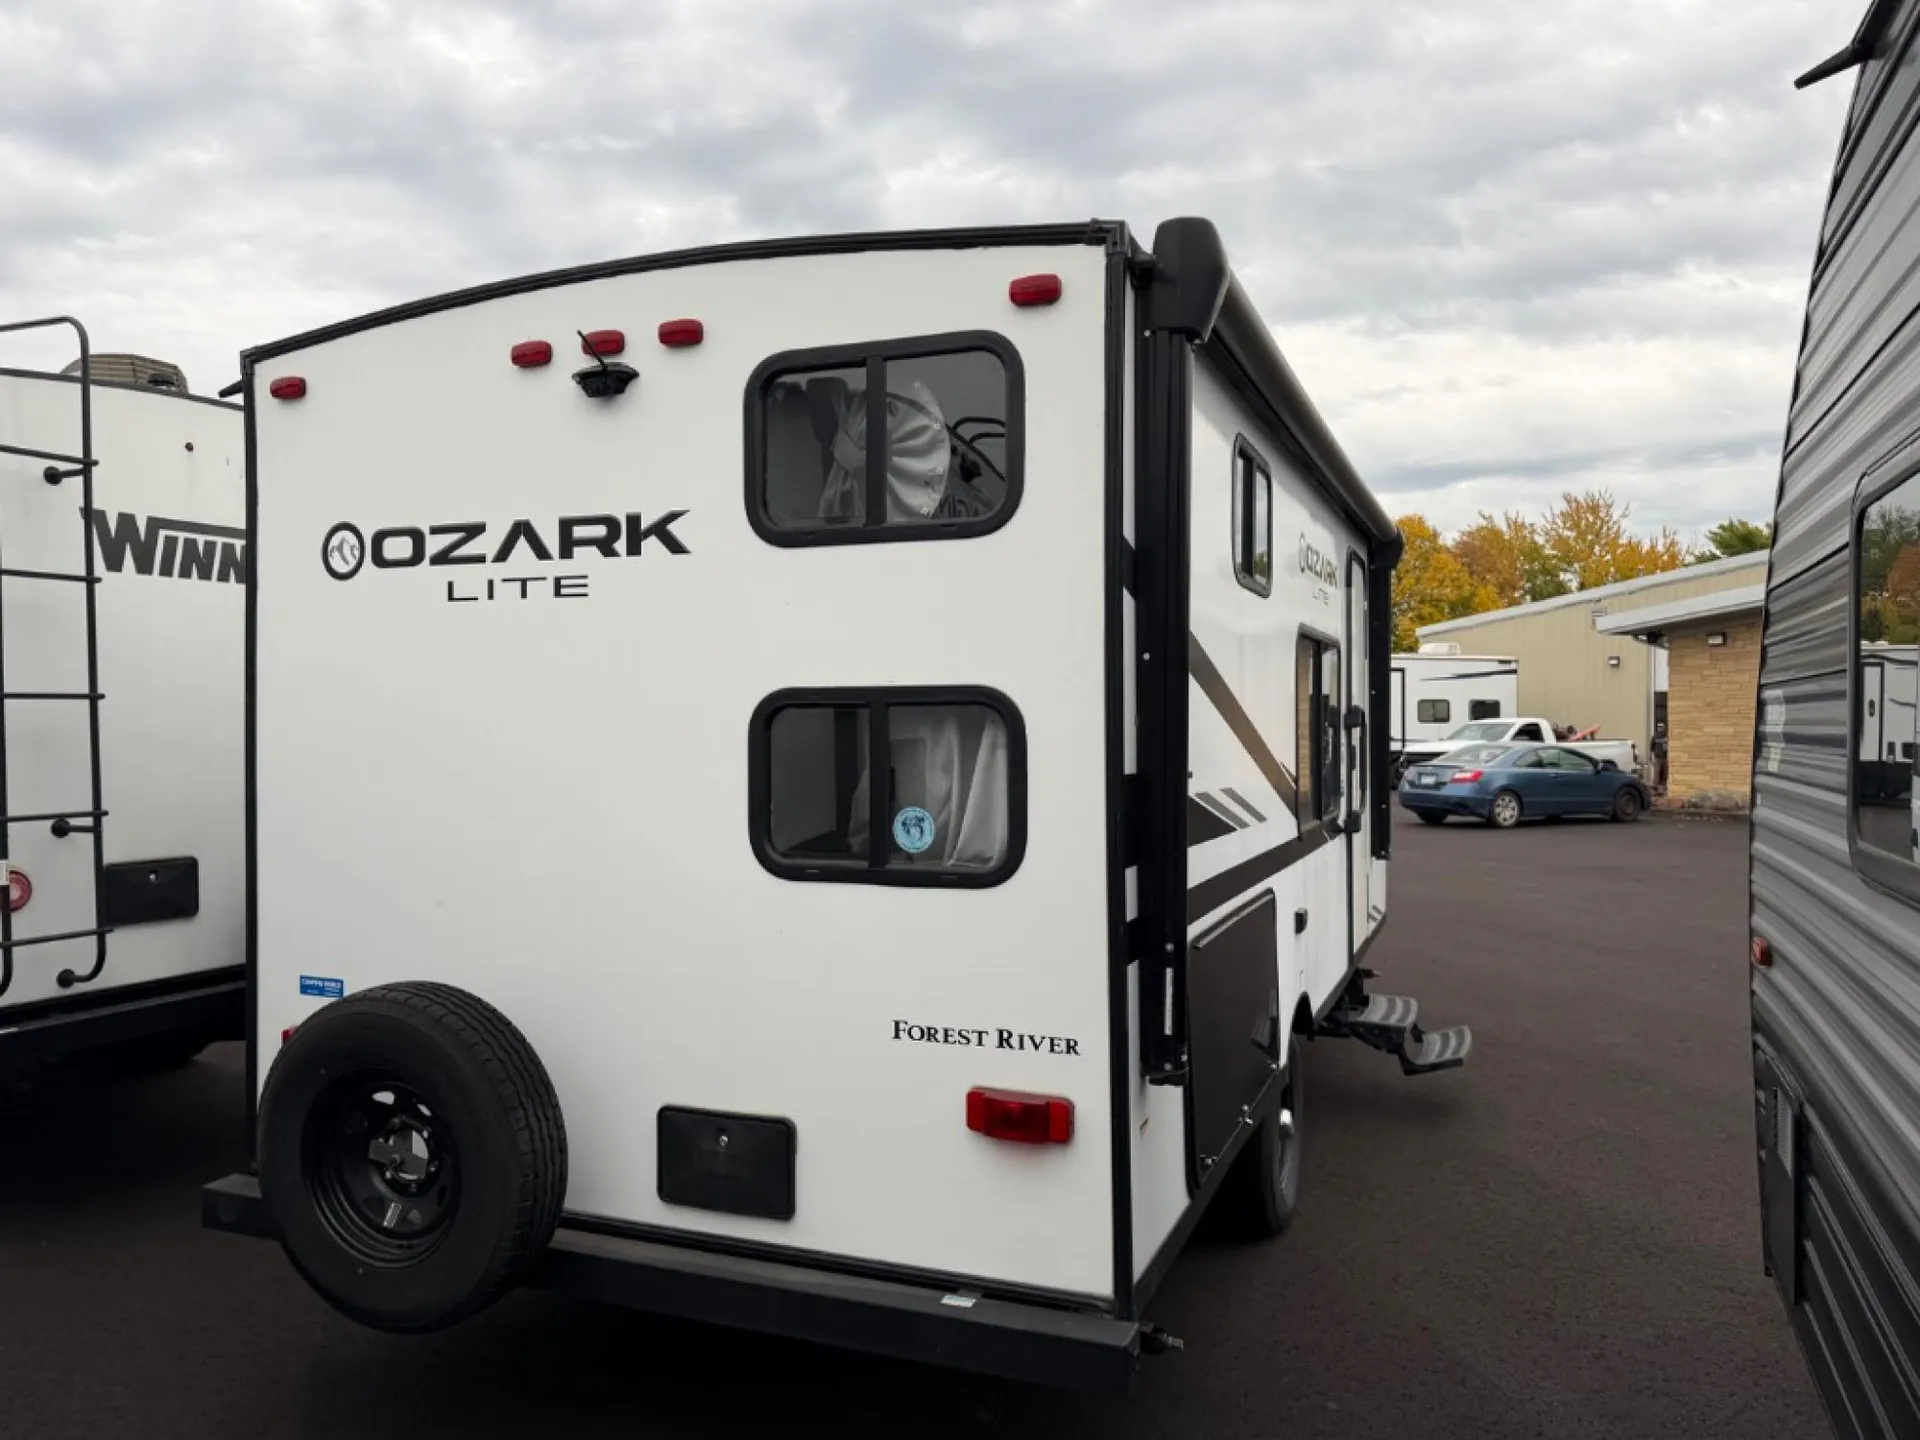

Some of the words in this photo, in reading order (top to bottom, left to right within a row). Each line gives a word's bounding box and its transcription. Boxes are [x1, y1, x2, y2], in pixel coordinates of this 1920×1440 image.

[371, 509, 692, 568] OZARK
[448, 575, 589, 602] LITE
[892, 1019, 989, 1047] FOREST
[995, 1027, 1080, 1056] RIVER
